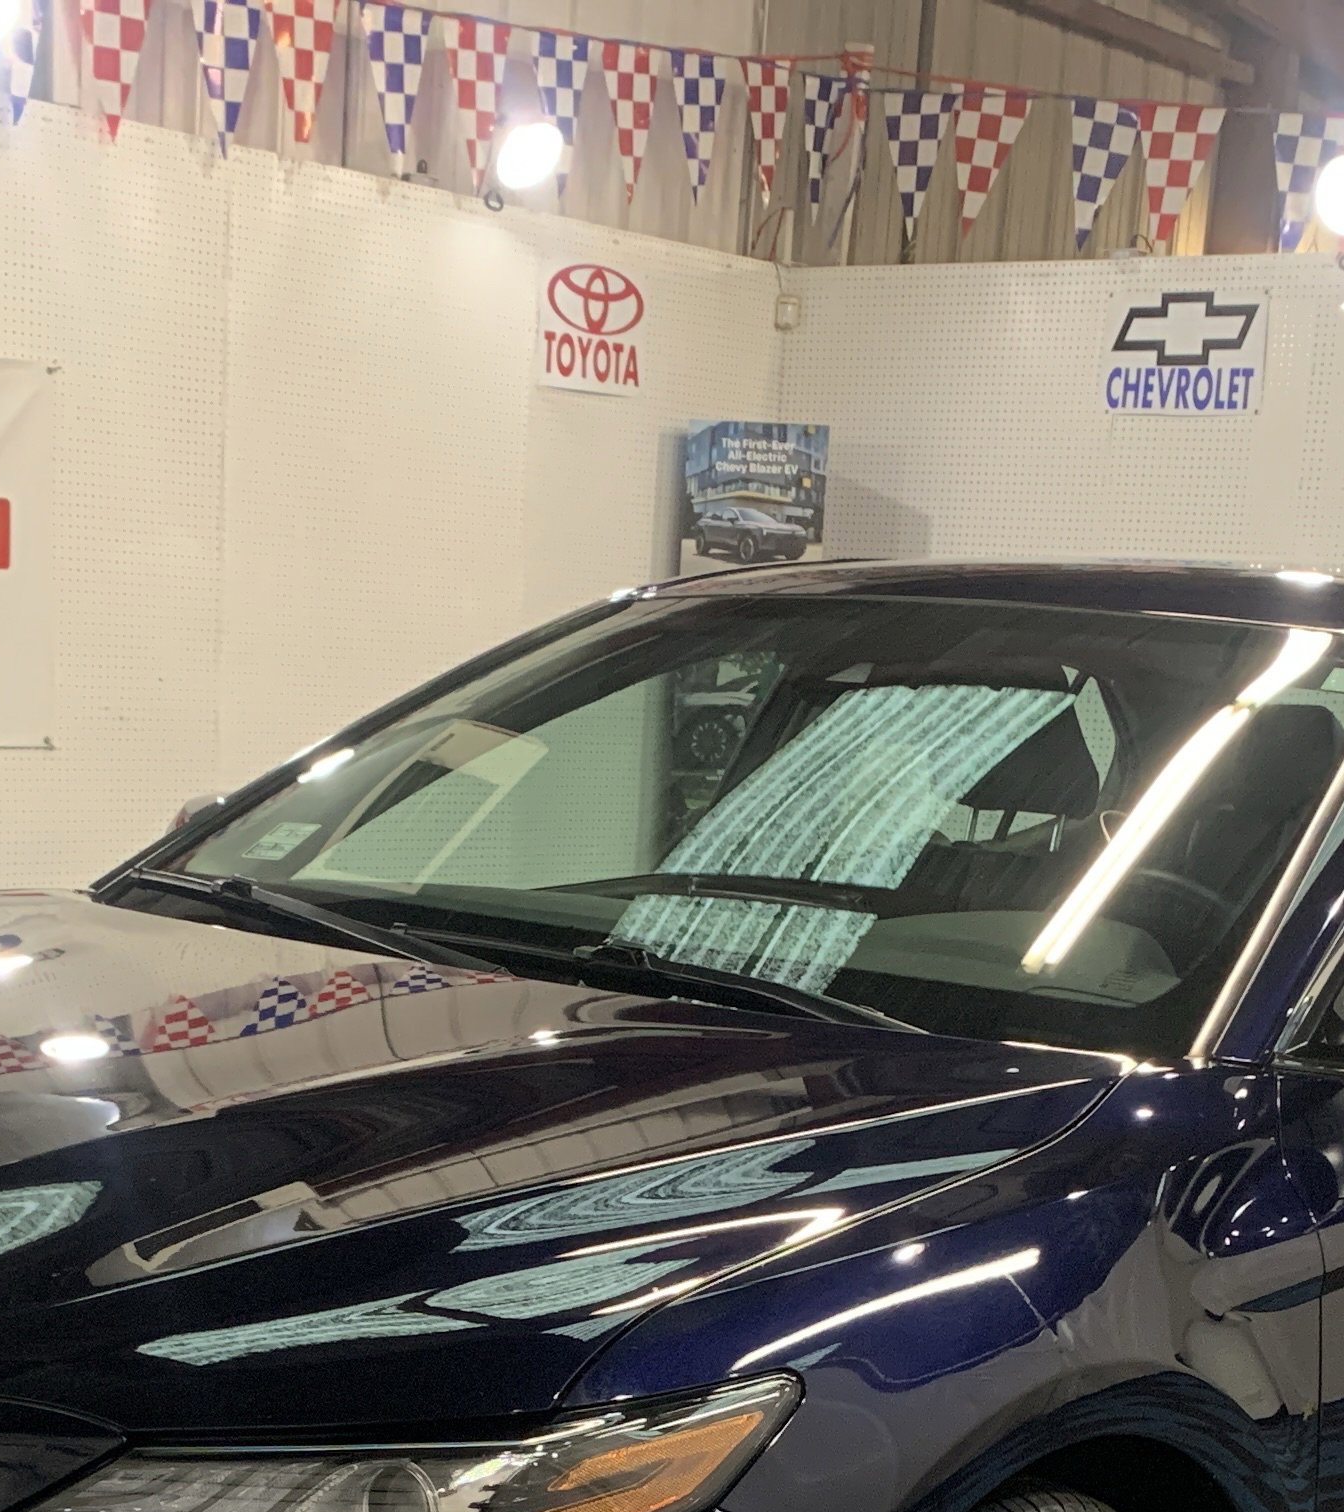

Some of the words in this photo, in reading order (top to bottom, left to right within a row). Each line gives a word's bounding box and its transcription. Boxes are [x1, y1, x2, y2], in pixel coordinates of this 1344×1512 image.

[544, 330, 640, 387] TOYOTA
[1106, 367, 1254, 410] CHEVROLET
[721, 438, 740, 448] The
[728, 451, 787, 463] All-Electric
[715, 461, 747, 474] Chevy
[749, 463, 782, 474] Blazer
[784, 464, 799, 475] EV
